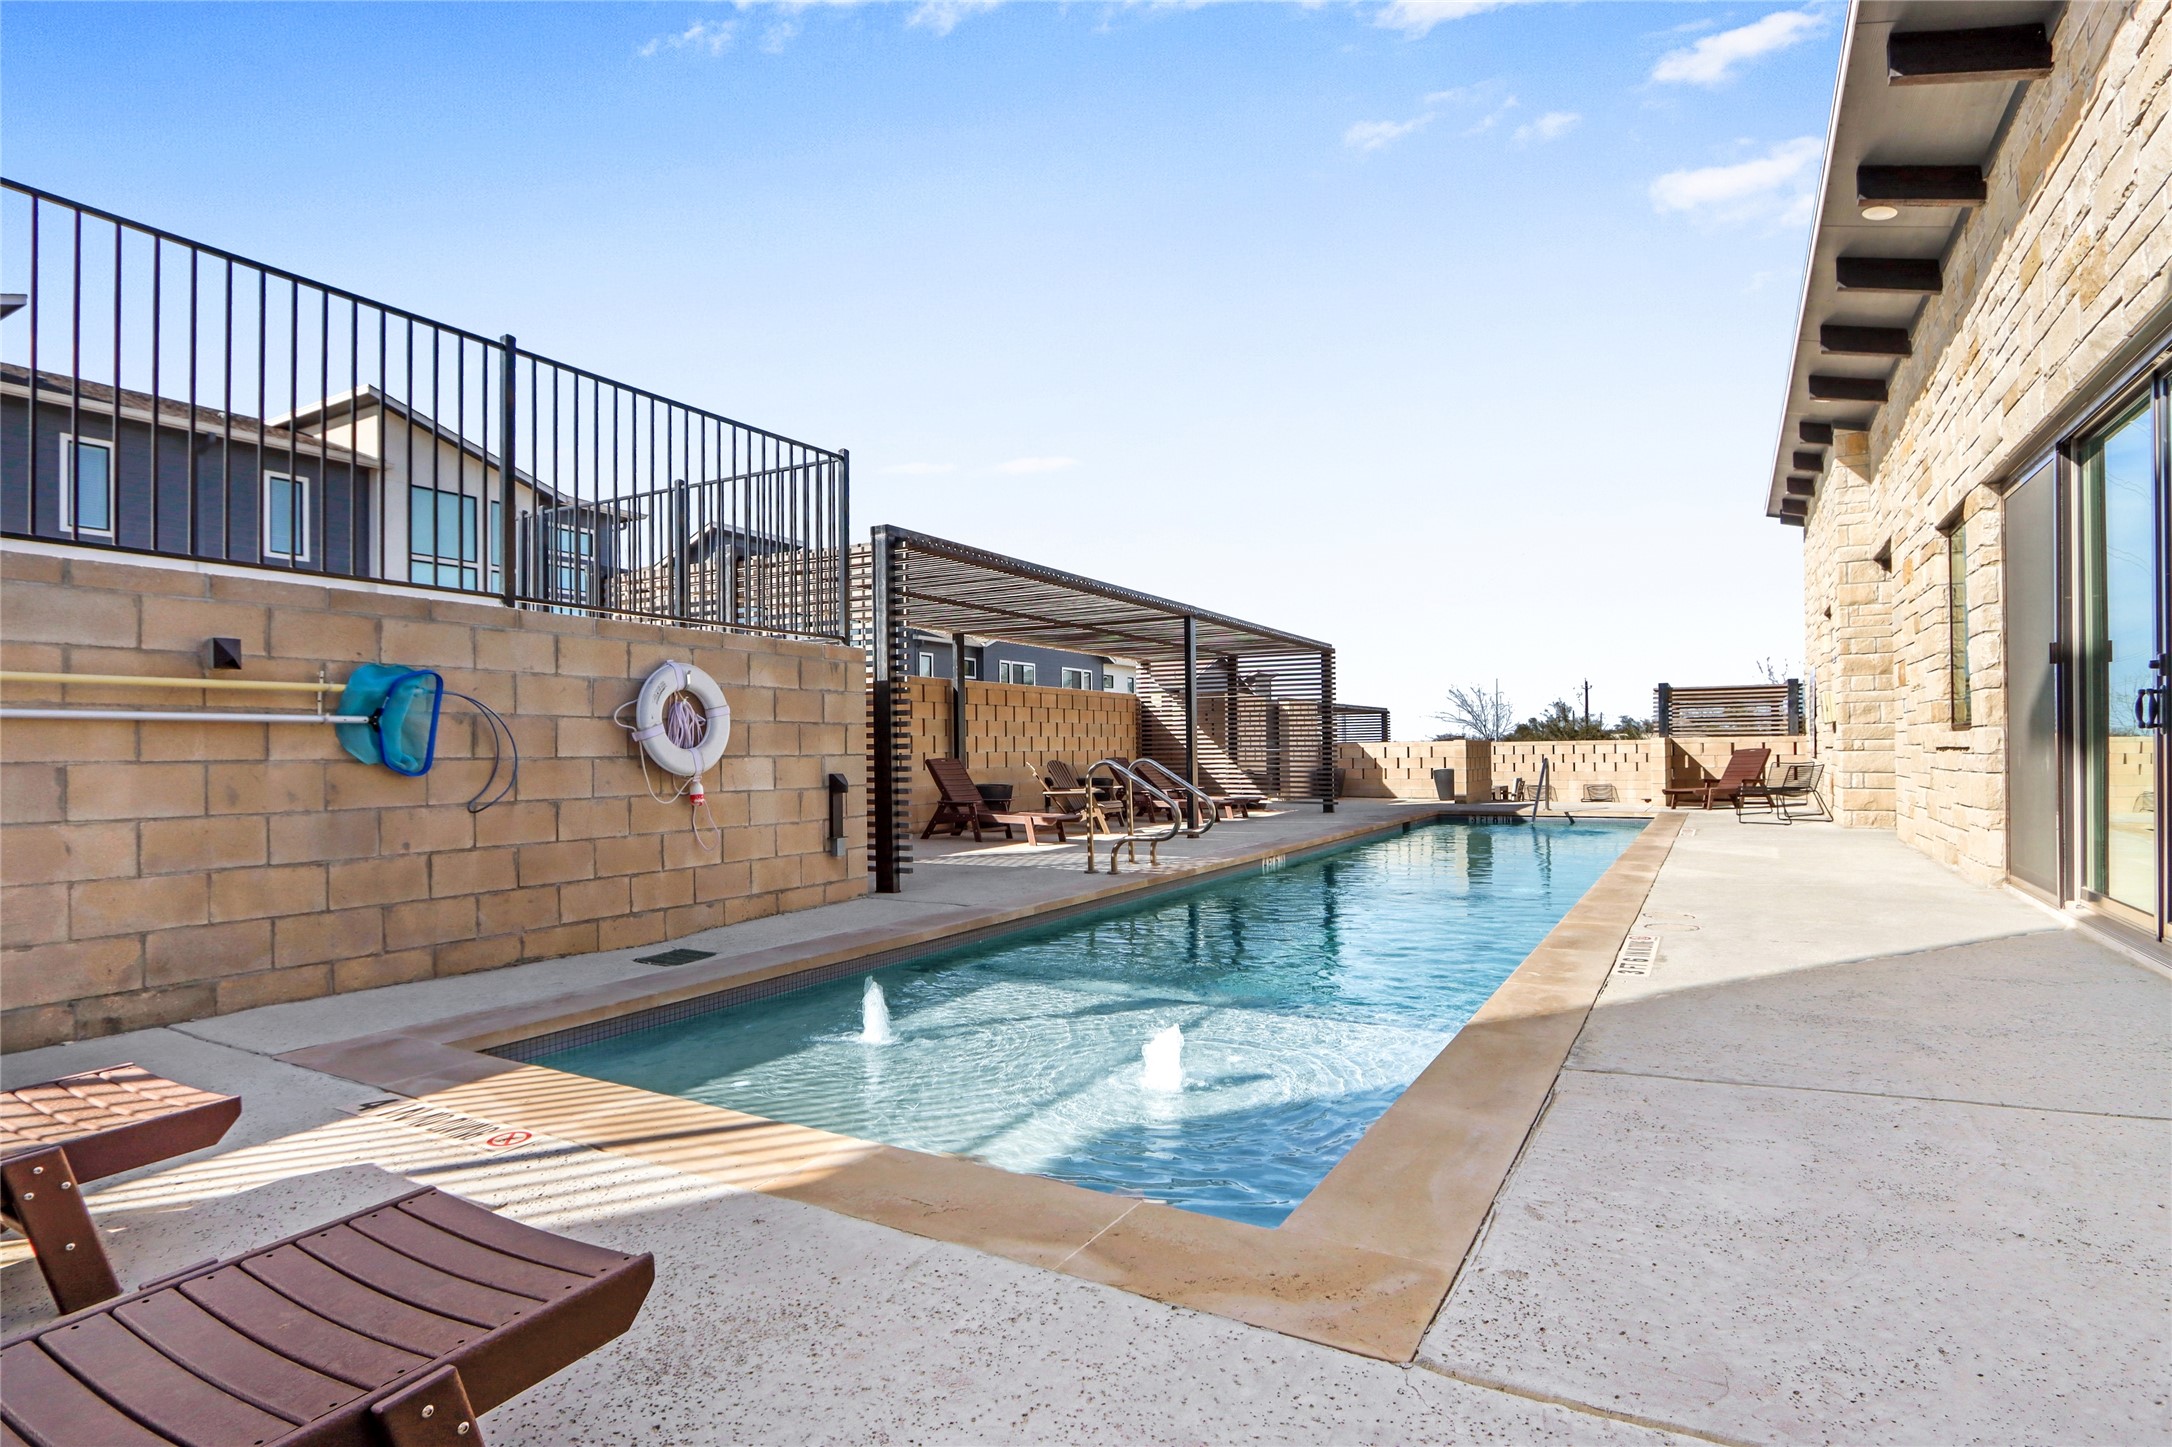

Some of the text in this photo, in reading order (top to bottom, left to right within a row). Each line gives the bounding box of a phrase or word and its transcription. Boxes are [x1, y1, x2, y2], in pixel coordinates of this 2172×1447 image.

[357, 1099, 400, 1111] 4
[376, 1103, 435, 1121] IN
[405, 1111, 455, 1127] NO
